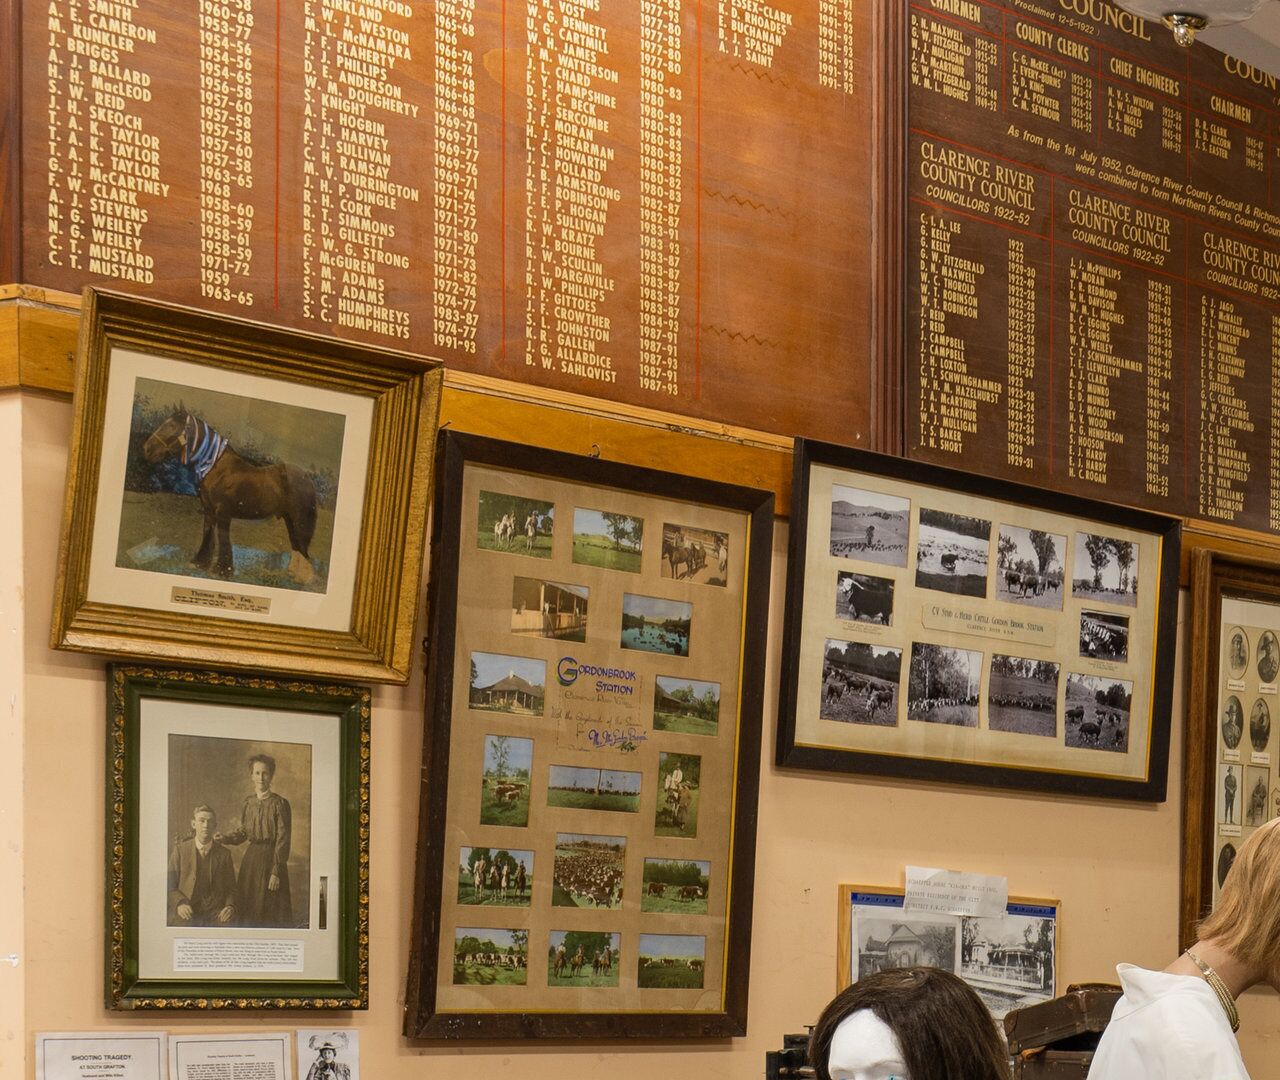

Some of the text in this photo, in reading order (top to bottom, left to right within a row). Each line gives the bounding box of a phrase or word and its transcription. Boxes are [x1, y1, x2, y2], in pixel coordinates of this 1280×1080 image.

[930, 0, 981, 23] CHAIRMEN
[1057, 0, 1151, 41] COUNCIL
[746, 50, 772, 68] SAINT
[1016, 22, 1089, 62] COUNTY CLERKS
[1110, 58, 1180, 97] CHIEF ENGINEERS
[1211, 95, 1251, 123] CHAIRMEN
[921, 142, 1034, 192] CLARENCE RIVER
[921, 161, 1035, 210] COUNTY COUNCIL
[1008, 125, 1019, 138] As
[1023, 131, 1043, 146] from
[1047, 138, 1060, 152] the
[1065, 144, 1076, 157] 1st
[1081, 150, 1098, 165] July
[1126, 164, 1160, 185] Clarence
[1163, 176, 1183, 192] River
[1186, 185, 1213, 203] County
[1216, 195, 1243, 213] Council
[926, 185, 1030, 226] COUNCILLORS 1922-52
[1069, 189, 1170, 235] CLARENCE RIVER
[1075, 163, 1095, 176] were
[1098, 171, 1137, 190] combined
[1141, 182, 1148, 194] to
[1152, 186, 1169, 200] form
[1172, 194, 1206, 212] Northern
[1208, 207, 1231, 221] Rivers
[1235, 214, 1260, 232] County
[1069, 207, 1170, 252] COUNTY COUNCIL
[1072, 229, 1164, 266] COUNCILLORS 1922-52
[1204, 232, 1259, 262] CLARENCE
[48, 252, 253, 306] C. T. MUSTARD 1963-65
[1203, 249, 1247, 275] COUNTY
[1207, 270, 1258, 293] COUNCILLORS
[303, 305, 476, 353] S. C. HUMPHREYS 1991-93
[525, 353, 678, 395] B. W. SAHLQVIST 1987-93
[940, 440, 962, 453] SHORT
[1008, 454, 1033, 468] 1929-31
[191, 590, 214, 598] Thomas
[557, 657, 636, 683] GORDONBROOK
[596, 681, 633, 695] STATION
